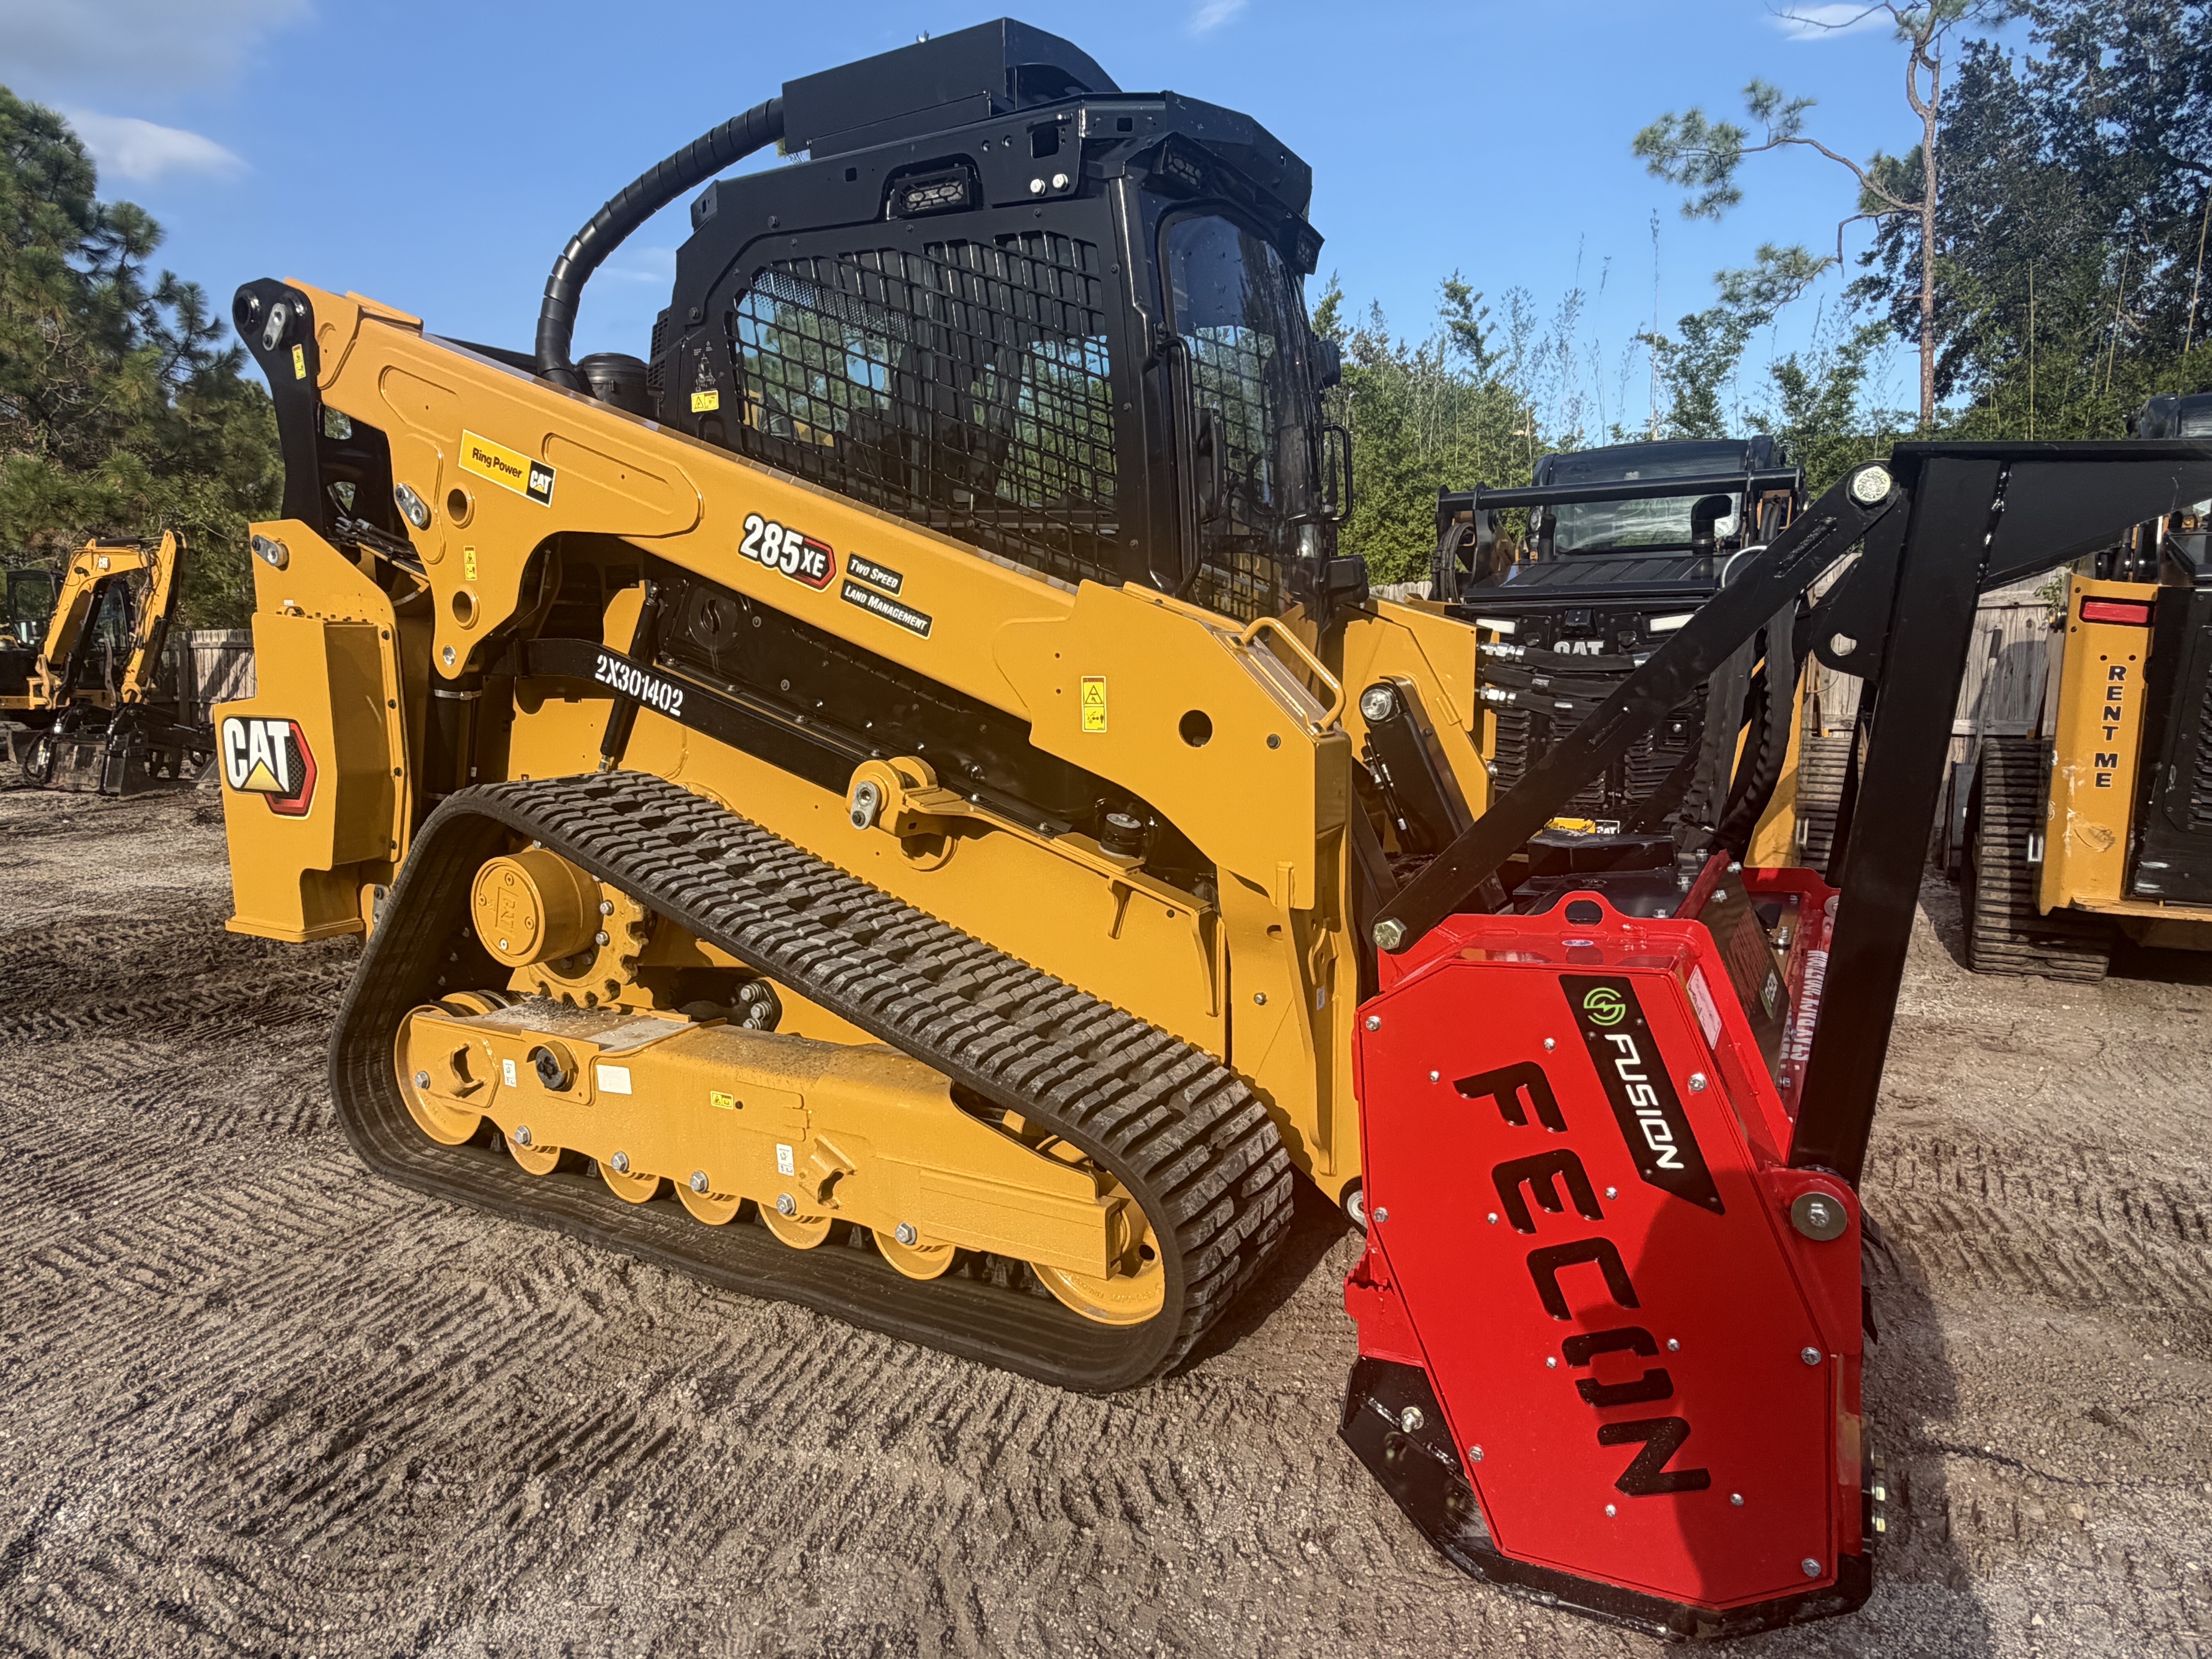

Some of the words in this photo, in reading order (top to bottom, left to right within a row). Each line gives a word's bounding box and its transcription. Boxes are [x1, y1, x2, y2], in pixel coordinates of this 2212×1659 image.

[472, 447, 492, 468] Ring
[493, 456, 523, 479] Power
[530, 470, 552, 494] CAT
[595, 654, 683, 717] 2X301402
[2102, 665, 2127, 741] RENT
[223, 718, 290, 792] CAT
[2094, 753, 2118, 788] ME
[1604, 1034, 1685, 1169] FUSION
[1452, 1060, 1712, 1497] FECON
